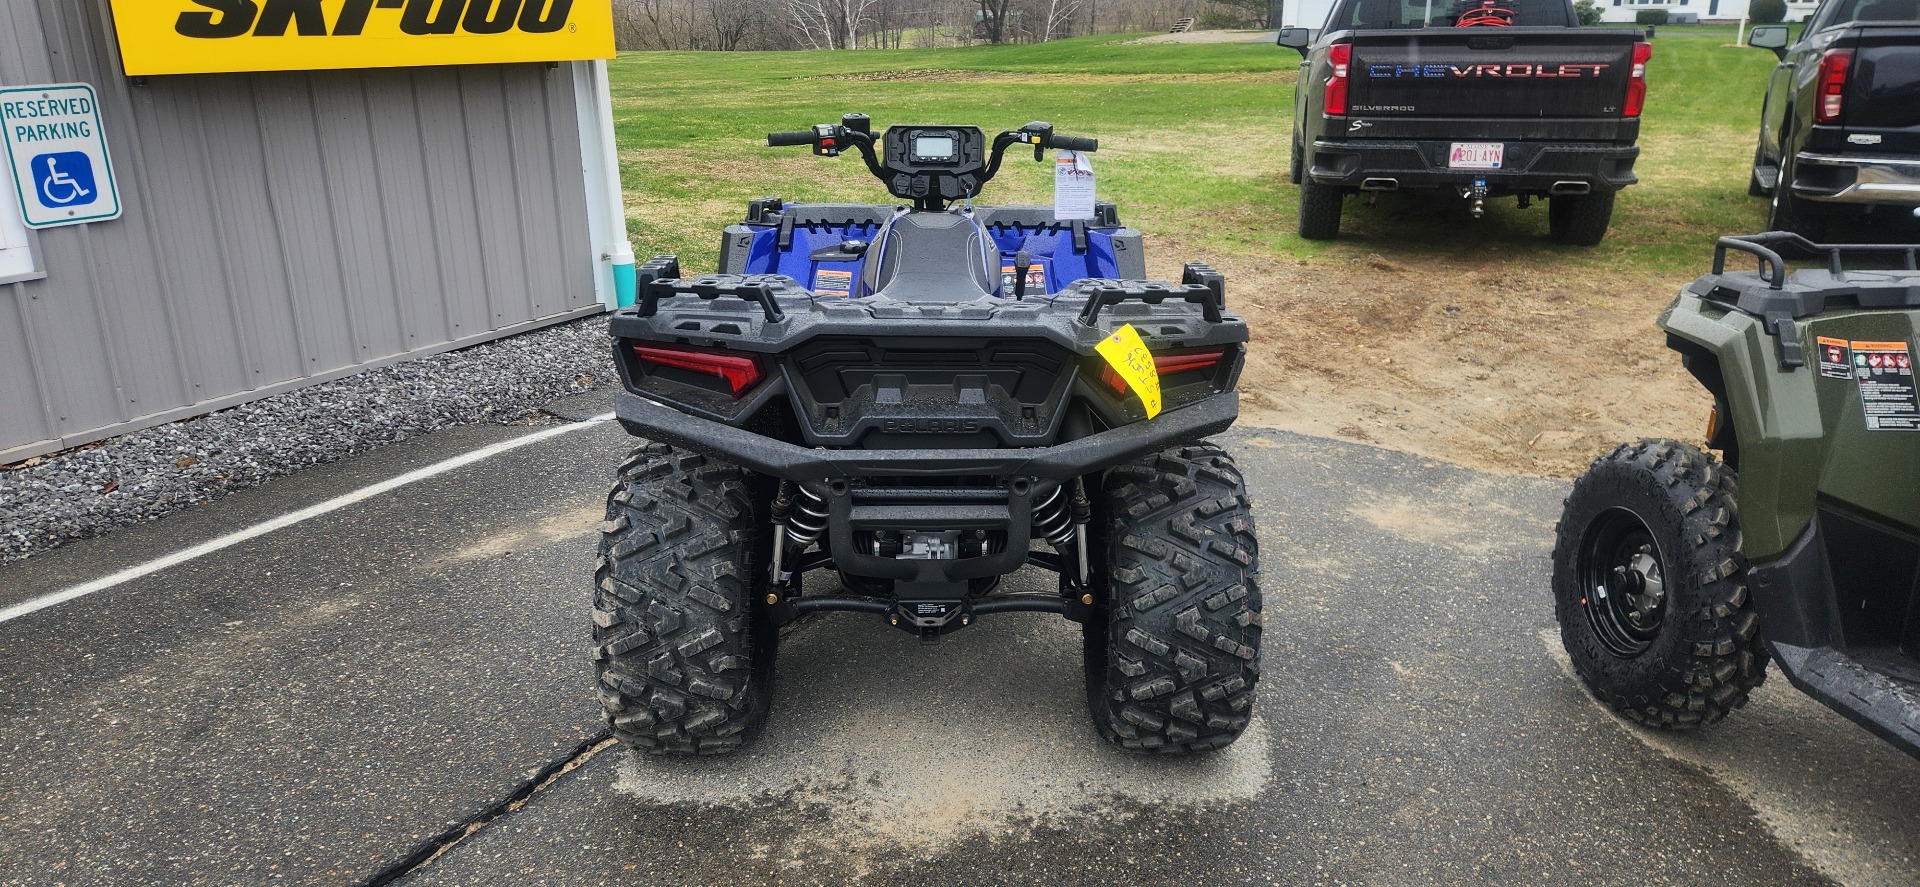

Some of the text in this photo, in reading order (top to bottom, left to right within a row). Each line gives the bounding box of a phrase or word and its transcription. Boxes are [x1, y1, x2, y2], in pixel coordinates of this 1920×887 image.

[1369, 64, 1609, 78] CHEVROLET
[4, 97, 91, 119] RESERVED
[15, 121, 91, 143] PARKING
[883, 419, 980, 433] POLARIS
